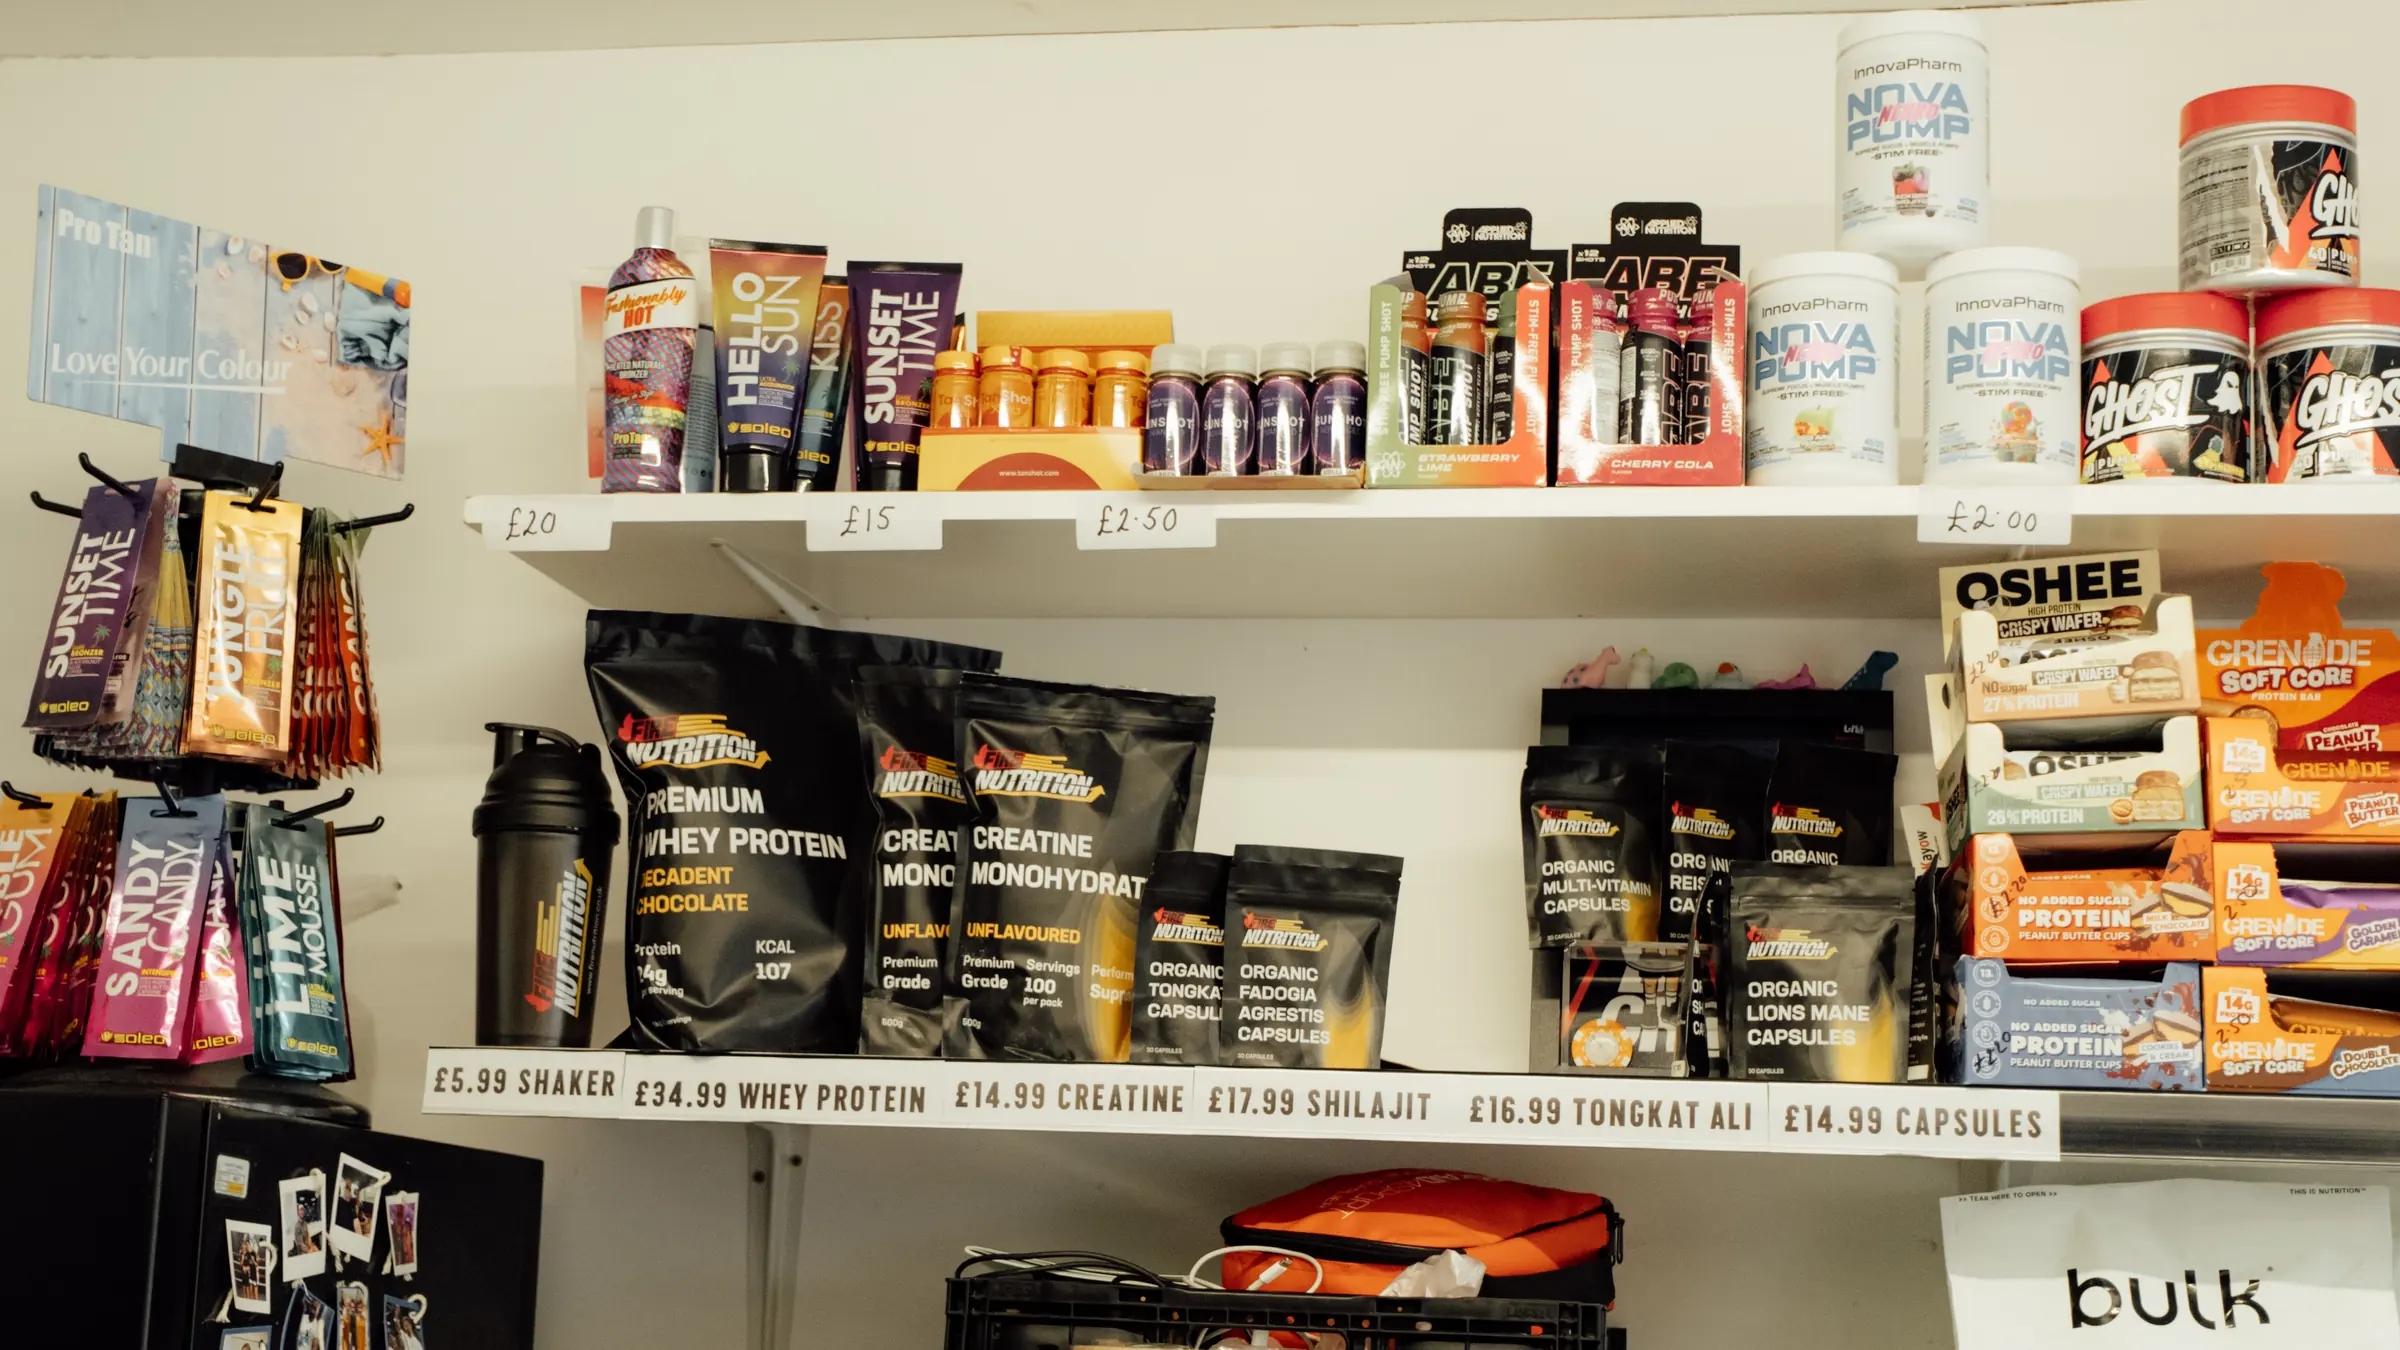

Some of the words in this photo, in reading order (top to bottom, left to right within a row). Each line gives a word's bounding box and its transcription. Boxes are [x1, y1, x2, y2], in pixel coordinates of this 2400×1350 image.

[1854, 57, 1962, 80] InnovaPharm
[1847, 82, 1969, 122] NOVA
[1847, 113, 1970, 152] PUMP
[58, 208, 101, 247] Pro
[105, 219, 152, 260] Tan
[604, 285, 687, 321] Fashionably
[1761, 298, 1869, 319] InnovaPharm
[1955, 296, 2065, 315] InnovaPharm
[623, 305, 656, 329] HOT
[762, 275, 802, 358] SUN
[1380, 300, 1393, 332] SHOT
[1571, 299, 1583, 329] SHOT
[727, 272, 765, 408] HELLO
[811, 301, 843, 372] KISS
[898, 290, 940, 376] TIME
[1755, 322, 1877, 361] NOVA
[1947, 320, 2069, 356] NOVA
[864, 289, 905, 425] SUNSET
[1379, 334, 1392, 369] PUMP
[1570, 333, 1582, 367] PUMP
[51, 343, 118, 376] Love
[124, 345, 190, 379] Your
[198, 348, 293, 383] Colour
[1946, 354, 2071, 384] PUMP
[1755, 355, 1877, 391] PUMP
[2084, 363, 2219, 457] GHOST
[739, 422, 792, 439] soleo
[1417, 454, 1521, 463] STRAWBERRY
[1417, 463, 1452, 473] LIME
[1611, 459, 1672, 469] CHERRY
[1673, 460, 1714, 470] COLA
[998, 470, 1060, 478] www.tanshot.com
[505, 507, 557, 542] £20
[840, 505, 896, 538] £15
[78, 525, 136, 626] TIME
[1956, 558, 2143, 611] OSHEE
[44, 531, 104, 680] SUNSET
[243, 545, 289, 658] FRUIT
[2027, 604, 2047, 616] HIGH
[2048, 603, 2082, 615] PROTEIN
[1999, 615, 2050, 639] CRISPY
[2051, 611, 2103, 631] WAFER
[2035, 670, 2076, 685] CRISPY
[2078, 666, 2119, 681] WAFER
[2220, 667, 2286, 694] SOFT
[2288, 666, 2354, 689] CORE
[1981, 681, 1999, 694] NO
[1999, 684, 2028, 695] sugar
[2251, 692, 2297, 701] PROTEIN
[2299, 692, 2321, 701] BAR
[48, 700, 91, 714] soleo
[2017, 692, 2080, 711] PROTEIN
[2310, 728, 2376, 747] PEANUT
[626, 734, 757, 766] NUTRITION
[975, 769, 1094, 798] NUTRITION
[2040, 785, 2083, 800] CRISPY
[2083, 783, 2126, 797] WAFER
[647, 785, 765, 819] PREMIUM
[2349, 794, 2397, 811] PEANUT
[1771, 815, 1836, 834] NUTRITION
[2021, 807, 2084, 825] PROTEIN
[2230, 809, 2270, 824] SOFT
[2271, 807, 2311, 821] CORE
[2348, 807, 2400, 824] BUTTER
[1540, 819, 1611, 834] NUTRITION
[1671, 815, 1730, 836] NUTRITION
[729, 827, 847, 860] PROTEIN
[973, 825, 1093, 859] CREATINE
[1541, 859, 1615, 876] ORGANIC
[1771, 849, 1839, 867] ORGANIC
[146, 838, 205, 953] CANDY
[1543, 875, 1652, 897] MULTI-VITAMIN
[636, 893, 749, 915] CHOCOLATE
[1544, 897, 1631, 915] CAPSULES
[2018, 896, 2038, 906] NO
[2041, 896, 2084, 906] ADDED
[2087, 896, 2131, 906] SUGAR
[105, 837, 165, 998] SANDY
[295, 863, 329, 978] MOUSSE
[2018, 909, 2132, 928] PROTEIN
[258, 855, 311, 1015] LIME
[966, 921, 1082, 946] UNFLAVOURED
[1242, 929, 1321, 948] NUTRITION
[2018, 931, 2060, 941] PEANUT
[2062, 931, 2101, 941] BUTTER
[2103, 931, 2131, 942] CUPS
[2351, 921, 2397, 940] GOLDEN
[554, 870, 589, 1017] NUTRITION
[755, 939, 796, 954] KCAL
[1746, 940, 1830, 958] NUTRITION
[2232, 936, 2274, 953] SOFT
[2276, 935, 2315, 950] CORE
[755, 962, 792, 981] 107
[882, 955, 939, 969] Premium
[962, 954, 1015, 970] Premium
[1026, 958, 1082, 977] Servings
[882, 974, 932, 990] Grade
[961, 973, 1008, 990] Grade
[1239, 964, 1319, 983] ORGANIC
[647, 986, 684, 999] serving
[1023, 977, 1057, 995] 100
[1239, 985, 1317, 1003] FADOGIA
[1747, 979, 1839, 998] ORGANIC
[1022, 995, 1039, 1007] per
[1040, 996, 1064, 1009] pack
[1238, 1005, 1325, 1024] AGRESTIS
[1746, 1004, 1806, 1022] LIONS
[1810, 1004, 1871, 1022] MANE
[112, 1031, 167, 1045] soleo
[1237, 1026, 1331, 1045] CAPSULES
[1747, 1028, 1857, 1047] CAPSULES
[2010, 1022, 2031, 1033] NO
[2033, 1022, 2077, 1034] ADDED
[2080, 1022, 2123, 1035] SUGAR
[297, 1041, 338, 1056] soleo
[1154, 1046, 1183, 1054] CAPSULES
[2010, 1036, 2123, 1058] PROTEIN
[2343, 1047, 2388, 1063] DOUBLE
[1756, 1067, 1785, 1075] CAPSULES
[2010, 1058, 2052, 1069] PEANUT
[2053, 1058, 2093, 1070] BUTTER
[2094, 1060, 2123, 1071] CUPS
[2222, 1059, 2264, 1076] SOFT
[2265, 1059, 2305, 1074] CORE
[2332, 1055, 2400, 1077] CHOCOLATE
[434, 1066, 507, 1095] £5.99
[517, 1067, 616, 1098] SHAKER
[635, 1080, 727, 1110] £34.99
[738, 1082, 808, 1111] WHEY
[817, 1084, 926, 1114] PROTEIN
[954, 1081, 1046, 1110] £14.99
[1057, 1083, 1185, 1113] CREATINE
[1207, 1086, 1295, 1116] £17.99
[1306, 1089, 1433, 1122] SHILAJIT
[1468, 1095, 1562, 1125] £16.99
[1572, 1097, 1700, 1130] TONGKAT
[1710, 1101, 1753, 1132] ALI
[1783, 1104, 1883, 1135] £14.99
[1895, 1106, 2043, 1140] CAPSULES
[1991, 1193, 2010, 1201] HERE
[2025, 1190, 2047, 1198] OPEN
[2066, 1267, 2271, 1331] bulk
